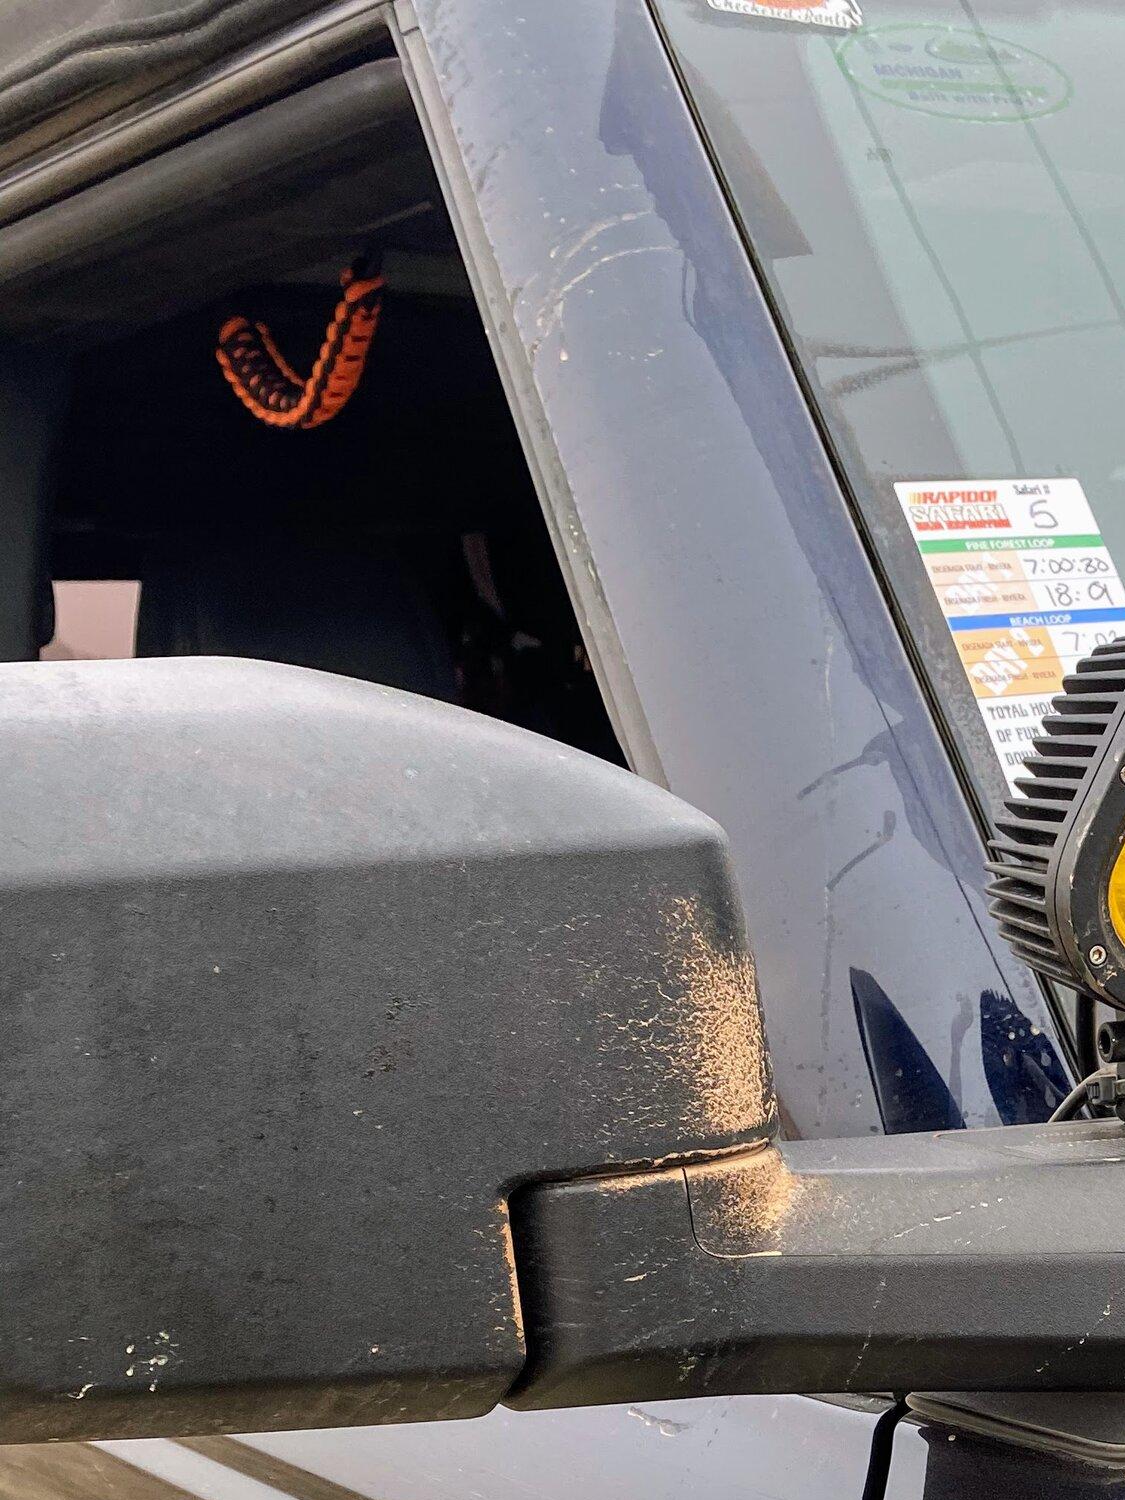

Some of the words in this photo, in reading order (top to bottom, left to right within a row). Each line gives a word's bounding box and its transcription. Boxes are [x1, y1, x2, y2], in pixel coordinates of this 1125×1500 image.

[909, 503, 1009, 524] SAFARI
[1029, 499, 1060, 529] 5
[990, 540, 1027, 550] FOREST
[1028, 538, 1056, 548] LOOP
[1008, 616, 1045, 627] BEACH
[1045, 614, 1073, 625] LOOP
[986, 703, 1029, 720] TOTAL
[995, 727, 1012, 743] OF
